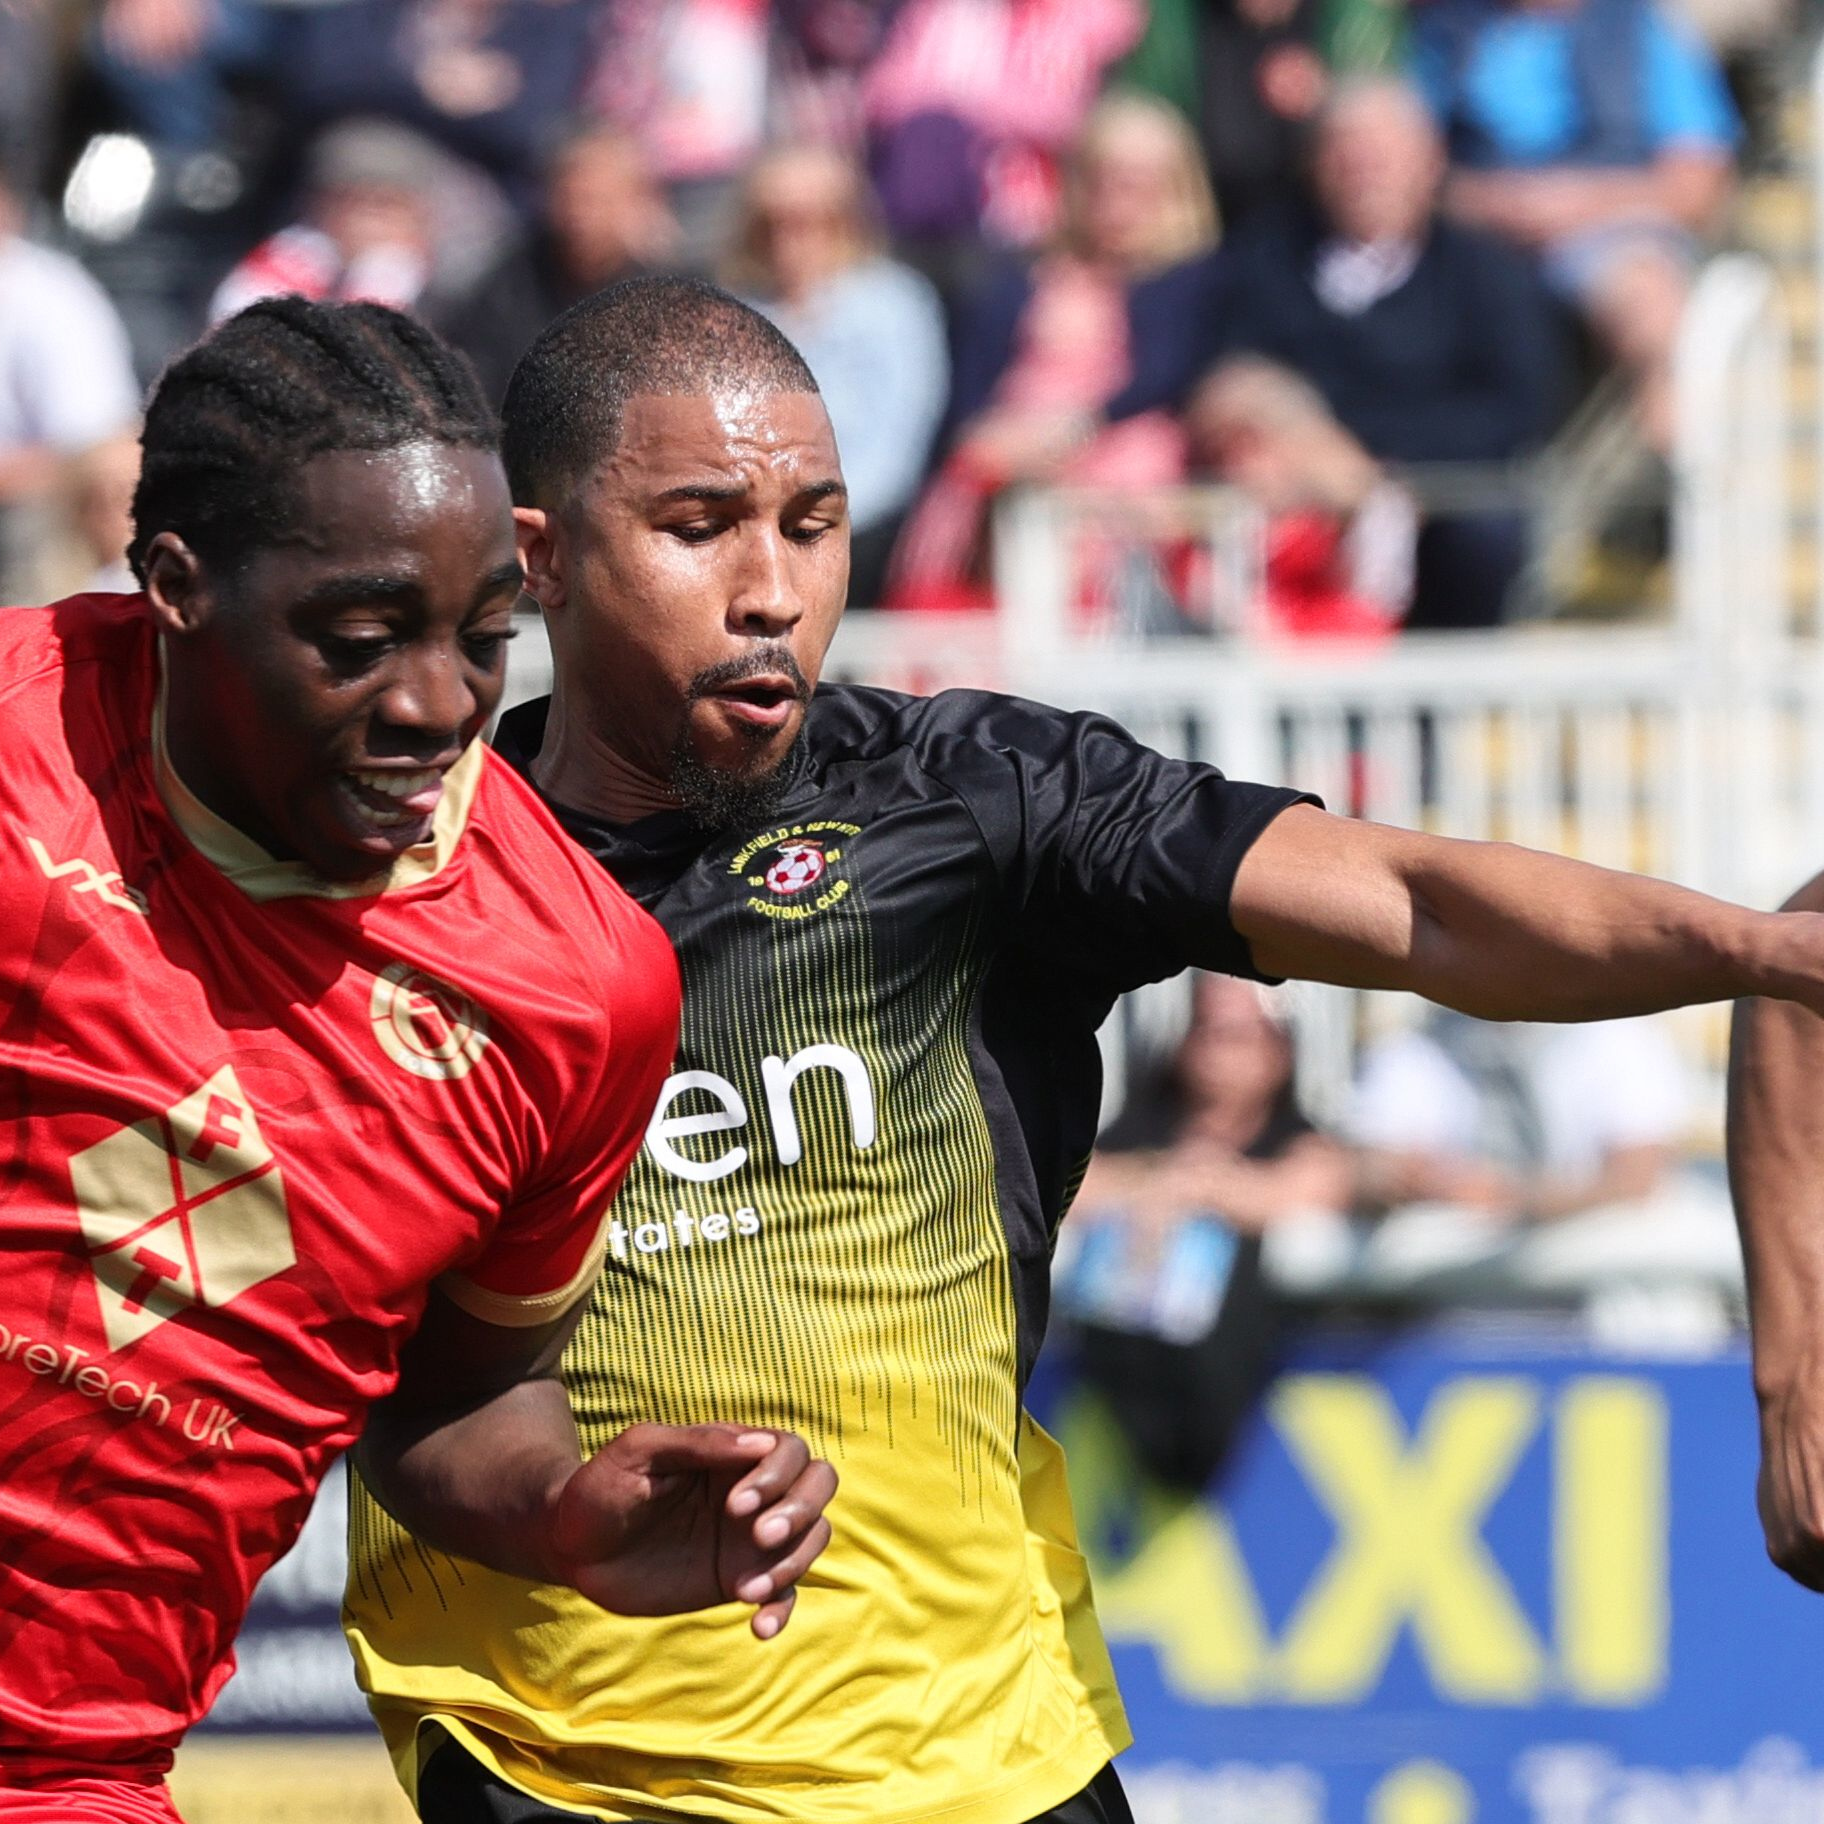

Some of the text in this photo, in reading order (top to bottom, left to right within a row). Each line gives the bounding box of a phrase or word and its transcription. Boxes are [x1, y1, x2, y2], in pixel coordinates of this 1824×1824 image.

[747, 875, 765, 887] 19
[747, 879, 850, 919] FOOTBALL CLUB
[645, 1043, 876, 1182] en
[608, 1206, 760, 1258] tates
[182, 1398, 246, 1450] UK
[1071, 1372, 1668, 1708] AXI
